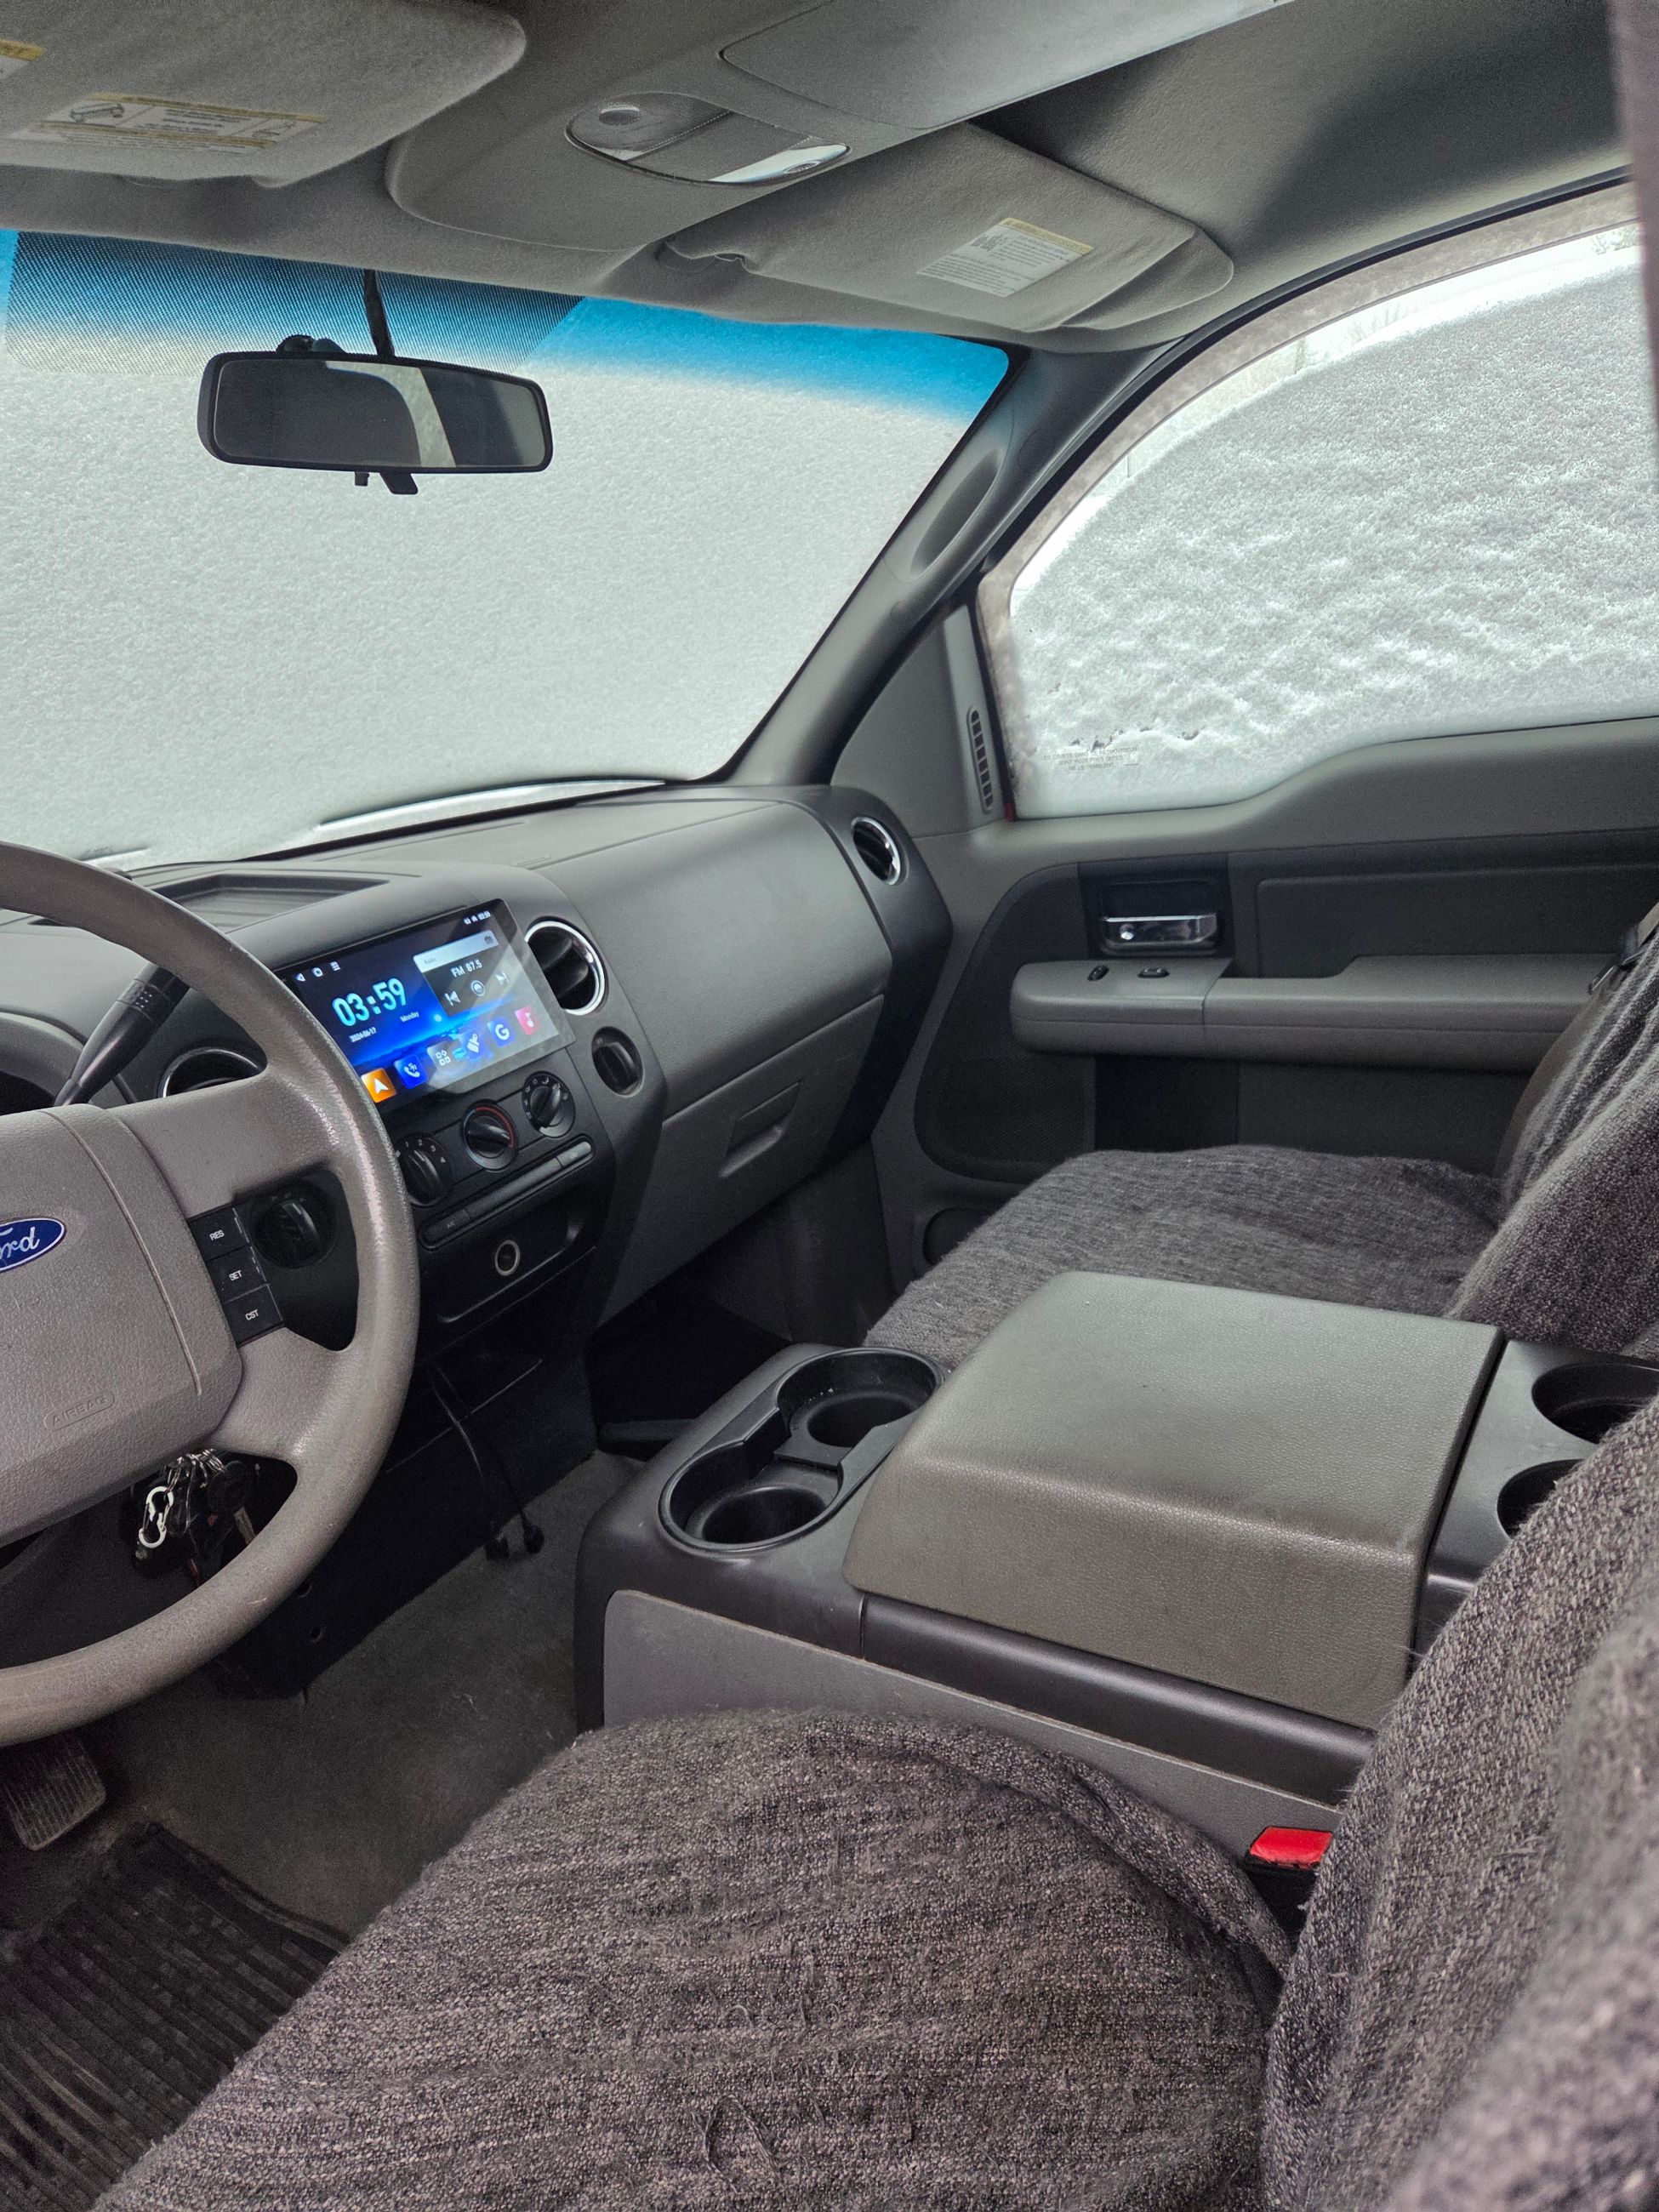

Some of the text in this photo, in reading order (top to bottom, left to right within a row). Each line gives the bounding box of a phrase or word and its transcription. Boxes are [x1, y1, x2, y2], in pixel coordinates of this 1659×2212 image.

[451, 959, 482, 978] FM 87.5
[332, 978, 407, 1027] 03:59
[400, 1012, 420, 1023] Monday
[209, 1229, 225, 1241] RES
[0, 1227, 40, 1259] rd
[229, 1269, 242, 1281] SET
[245, 1308, 259, 1320] CST
[52, 1396, 109, 1427] AIRBAG
